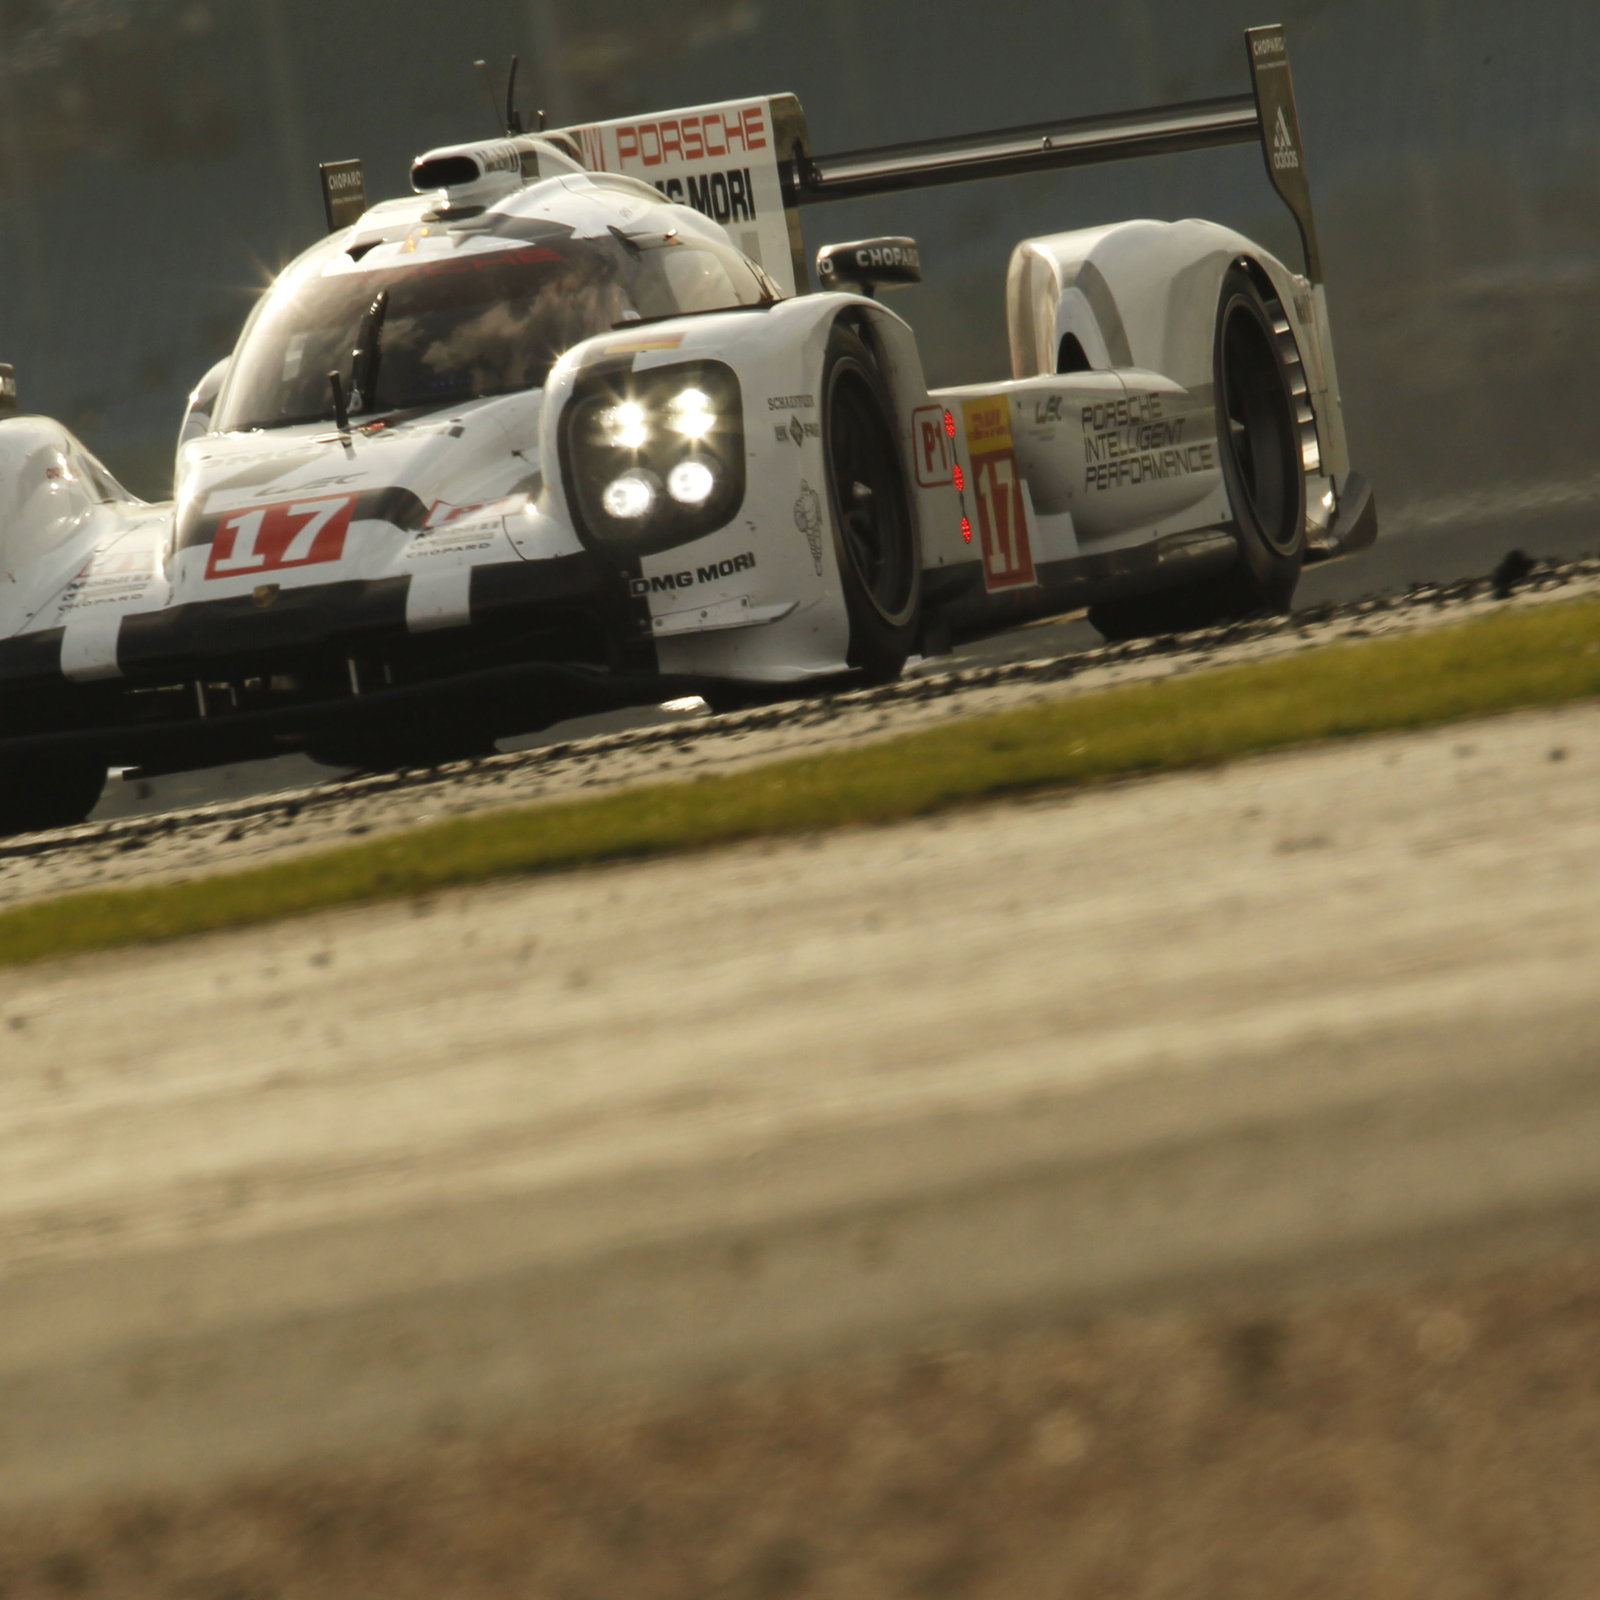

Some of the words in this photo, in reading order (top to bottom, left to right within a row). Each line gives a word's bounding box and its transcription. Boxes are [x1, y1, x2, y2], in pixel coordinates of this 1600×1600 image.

[616, 107, 767, 170] PORSCHE
[328, 170, 362, 190] CHOPARD
[686, 168, 757, 225] MORI
[1081, 392, 1162, 432] PORSCHE
[922, 420, 948, 474] P1
[1083, 417, 1186, 463] INTELLIGENT
[1084, 443, 1215, 492] PERFORMANCE
[214, 496, 351, 573] 17
[977, 457, 1019, 577] 17
[628, 570, 694, 597] DMG
[695, 551, 757, 584] MORI
